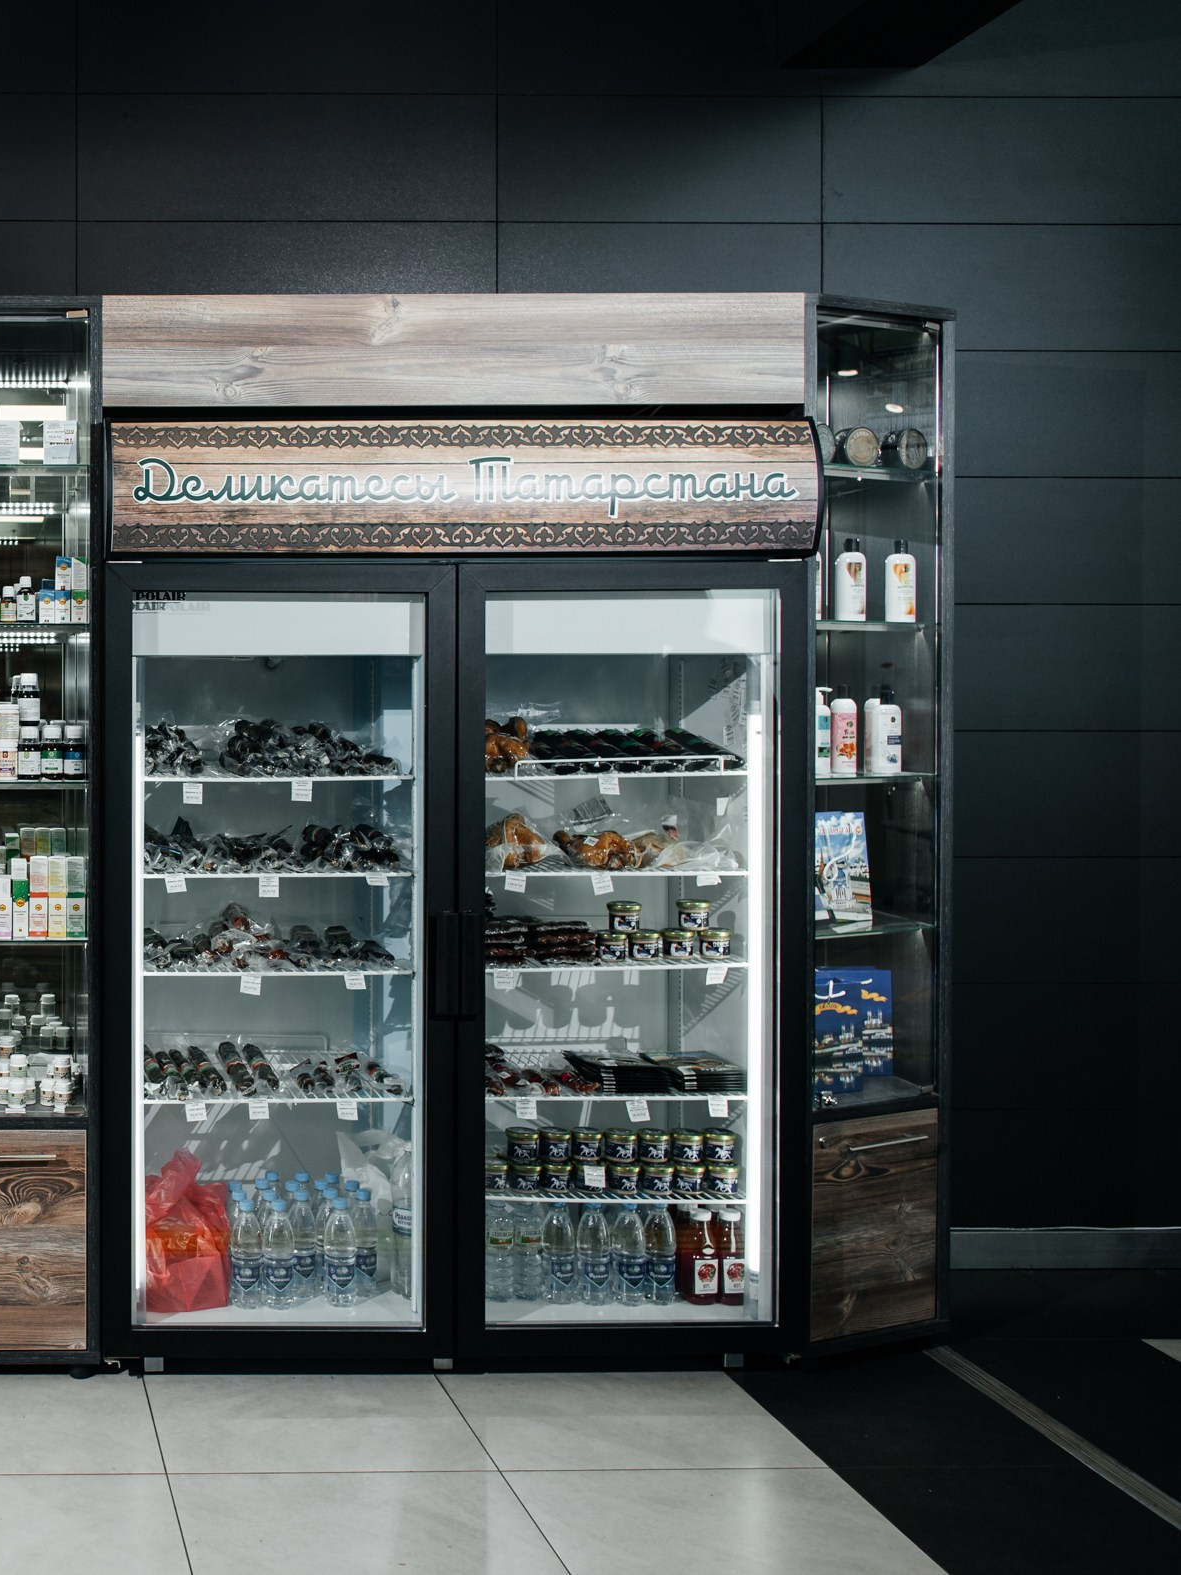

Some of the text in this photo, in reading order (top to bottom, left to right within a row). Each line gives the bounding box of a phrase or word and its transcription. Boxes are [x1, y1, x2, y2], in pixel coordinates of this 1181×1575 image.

[133, 456, 800, 519] Деликатесы Татарстана
[135, 591, 187, 601] POLAIR
